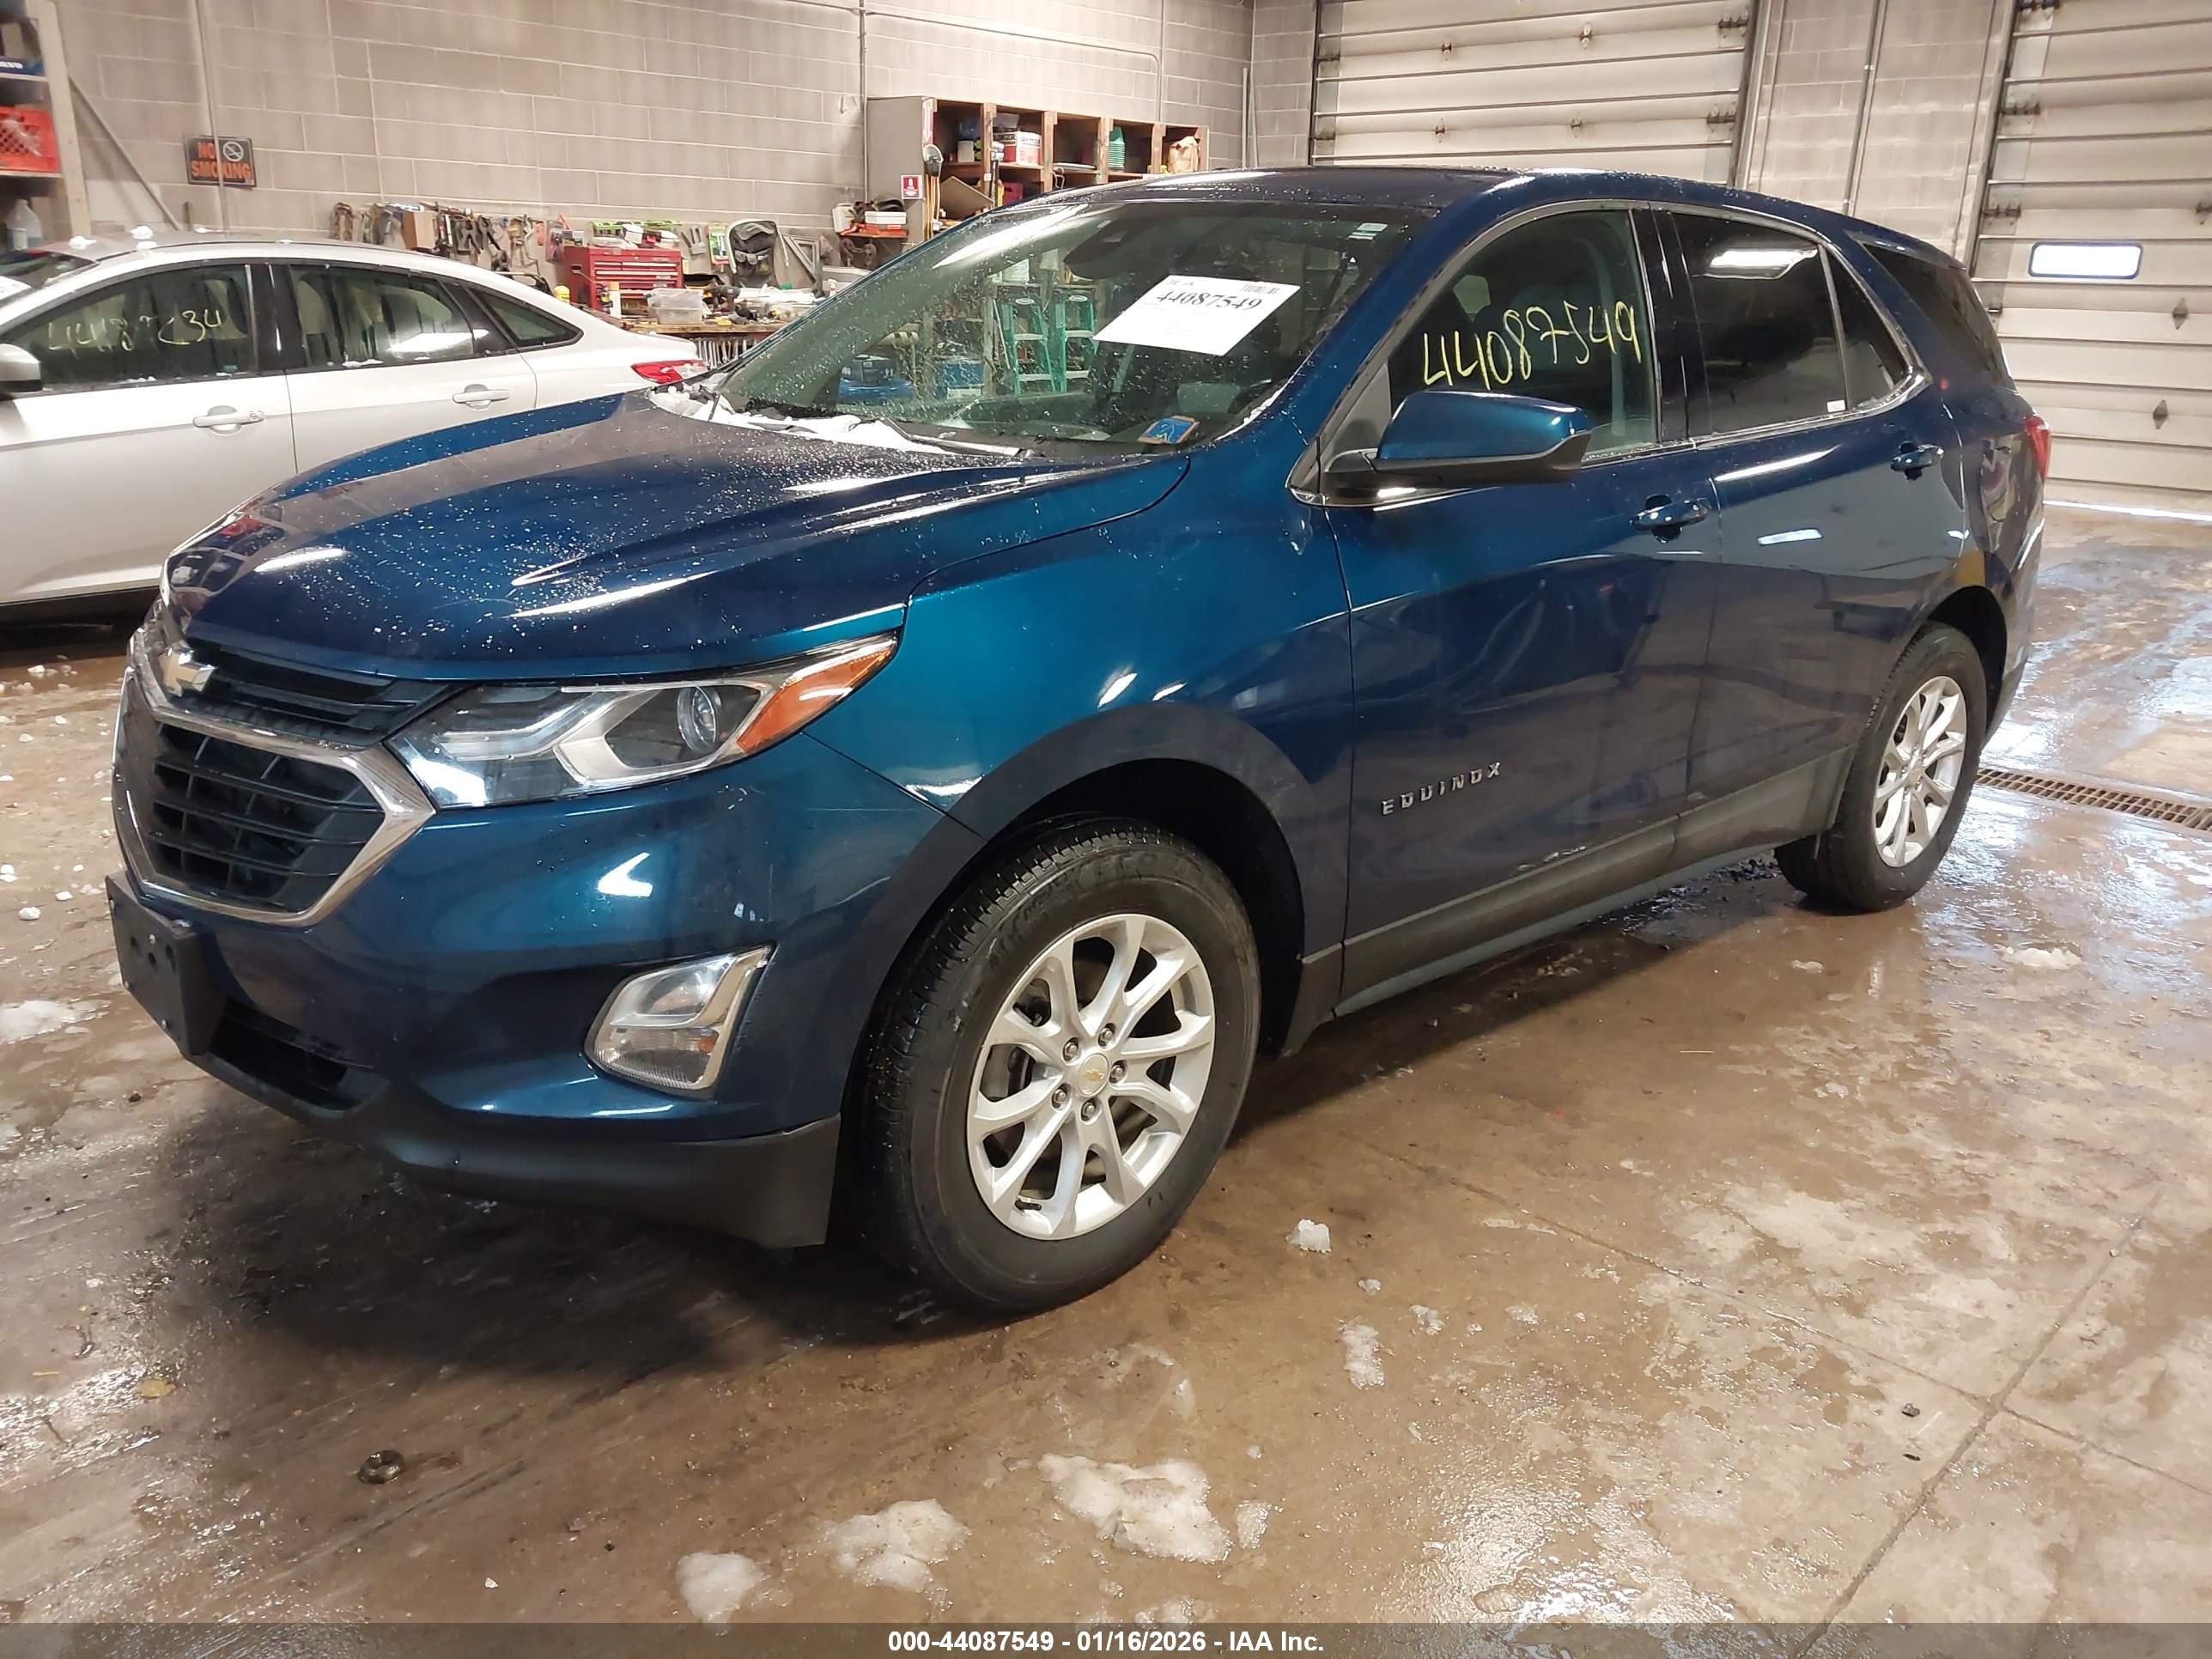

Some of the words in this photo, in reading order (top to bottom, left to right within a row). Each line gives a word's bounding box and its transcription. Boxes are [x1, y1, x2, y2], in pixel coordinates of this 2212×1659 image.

[198, 141, 216, 160] NO
[191, 160, 252, 179] SMOING
[1157, 290, 1262, 310] 44087549
[1423, 301, 1643, 391] 44087549
[1381, 762, 1501, 816] EQUINOX
